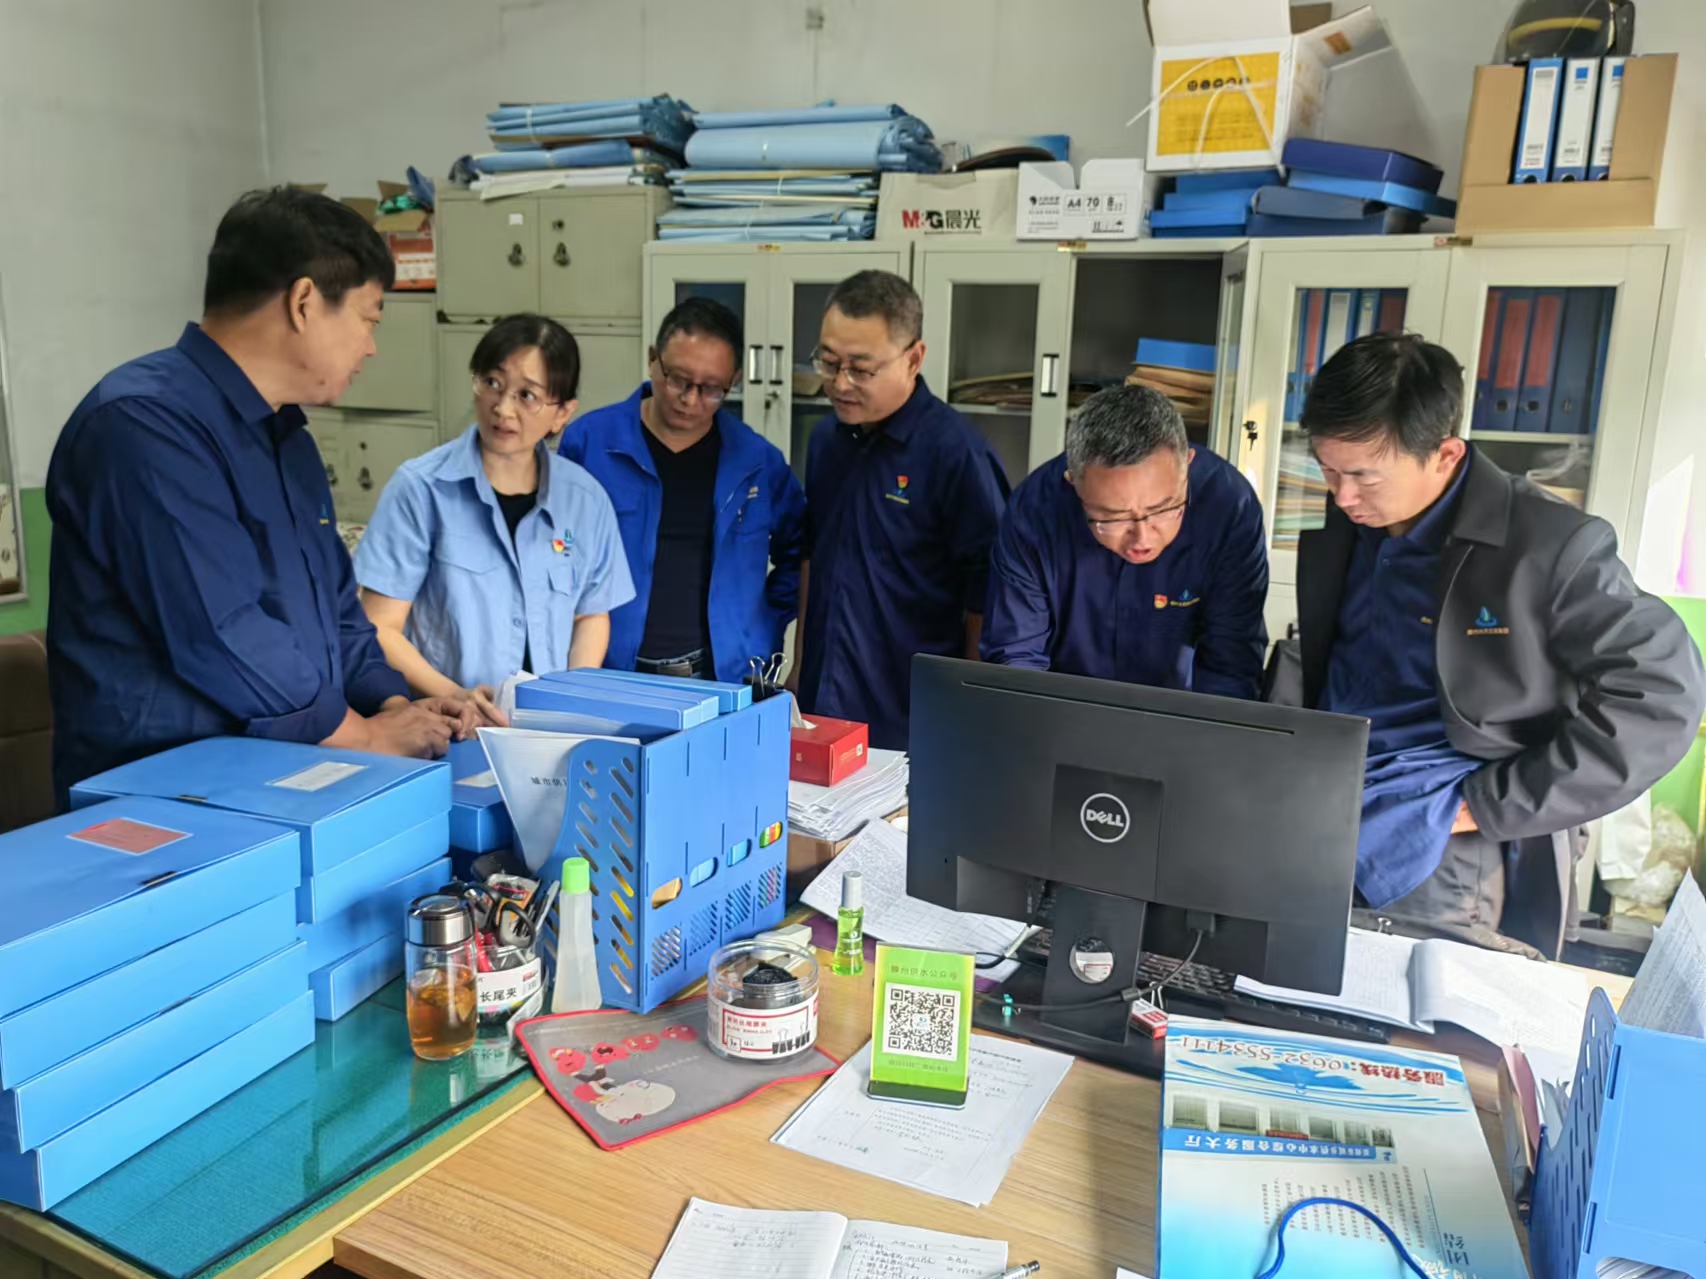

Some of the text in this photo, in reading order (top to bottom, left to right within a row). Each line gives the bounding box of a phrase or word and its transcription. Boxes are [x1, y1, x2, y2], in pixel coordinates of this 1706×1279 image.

[1067, 198, 1082, 209] A4
[1086, 196, 1100, 207] 70
[531, 776, 567, 787] 城市供
[1086, 809, 1124, 828] DELL
[479, 986, 518, 1002] 长尾夹
